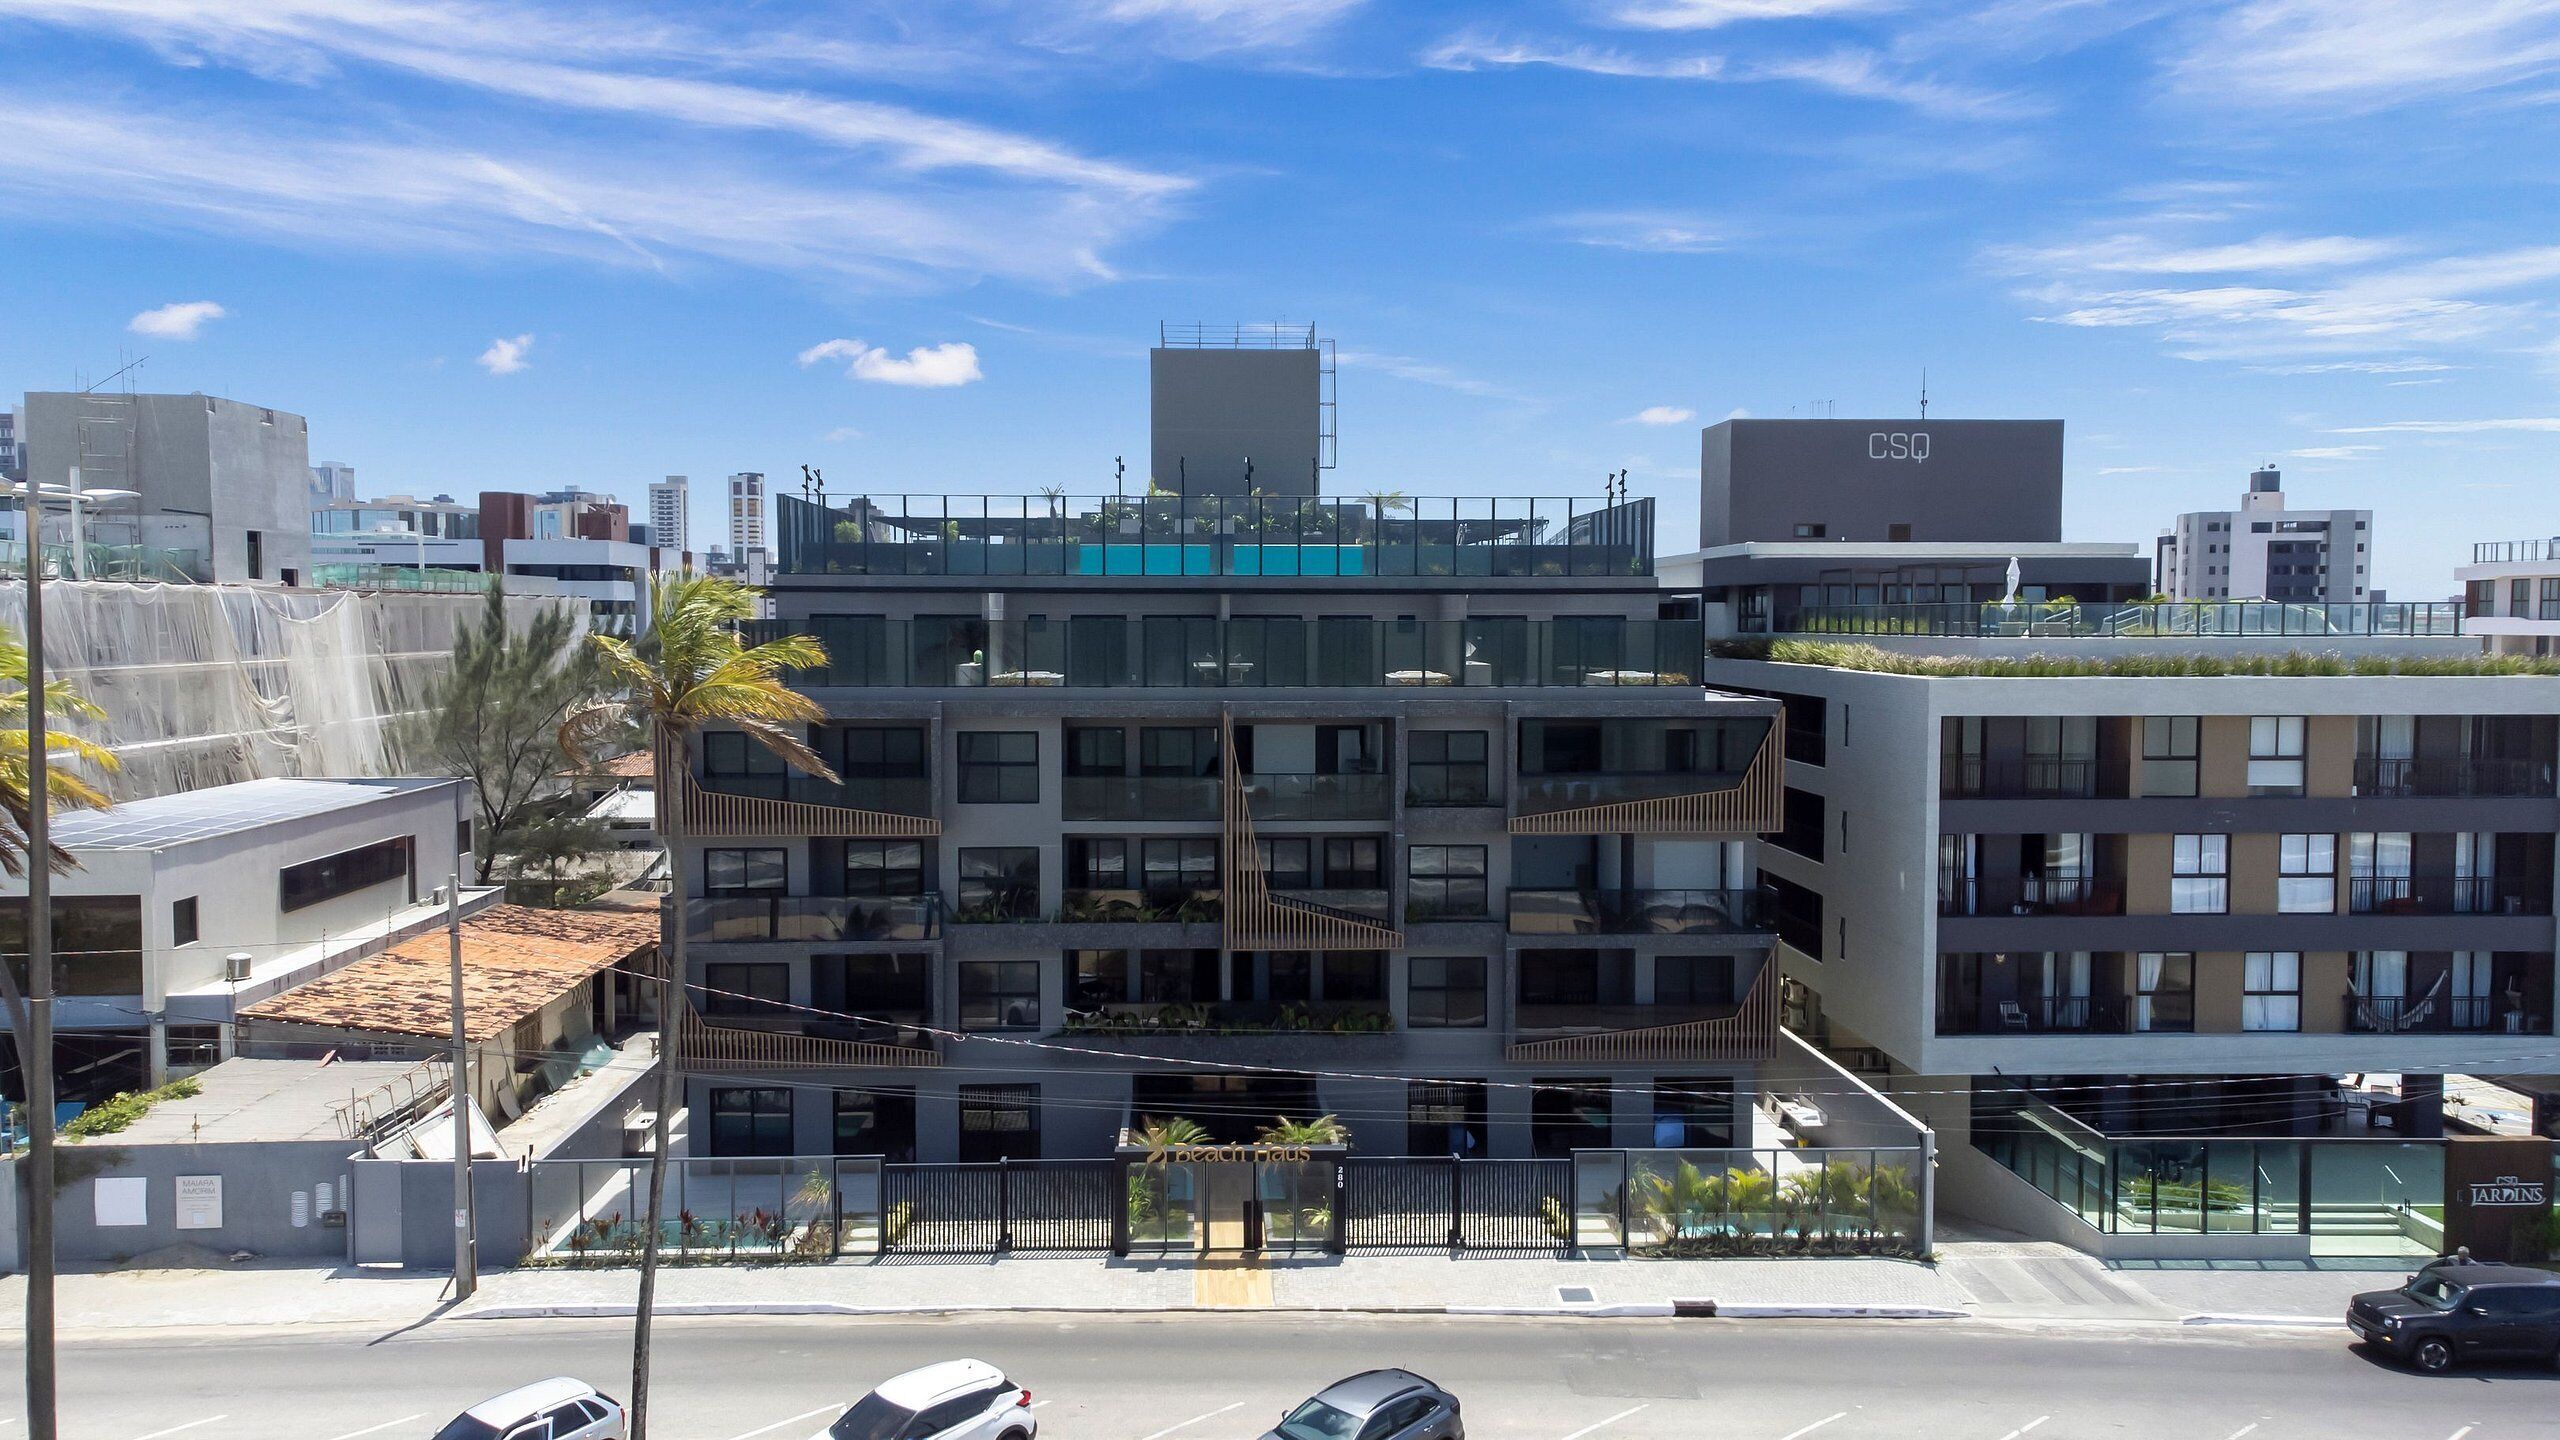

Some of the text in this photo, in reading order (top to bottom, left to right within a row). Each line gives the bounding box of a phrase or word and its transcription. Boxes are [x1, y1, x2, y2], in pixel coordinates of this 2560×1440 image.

[1869, 433, 1930, 463] CSQ
[1253, 1142, 1311, 1162] Haus
[2471, 1187, 2544, 1205] JARDINS
